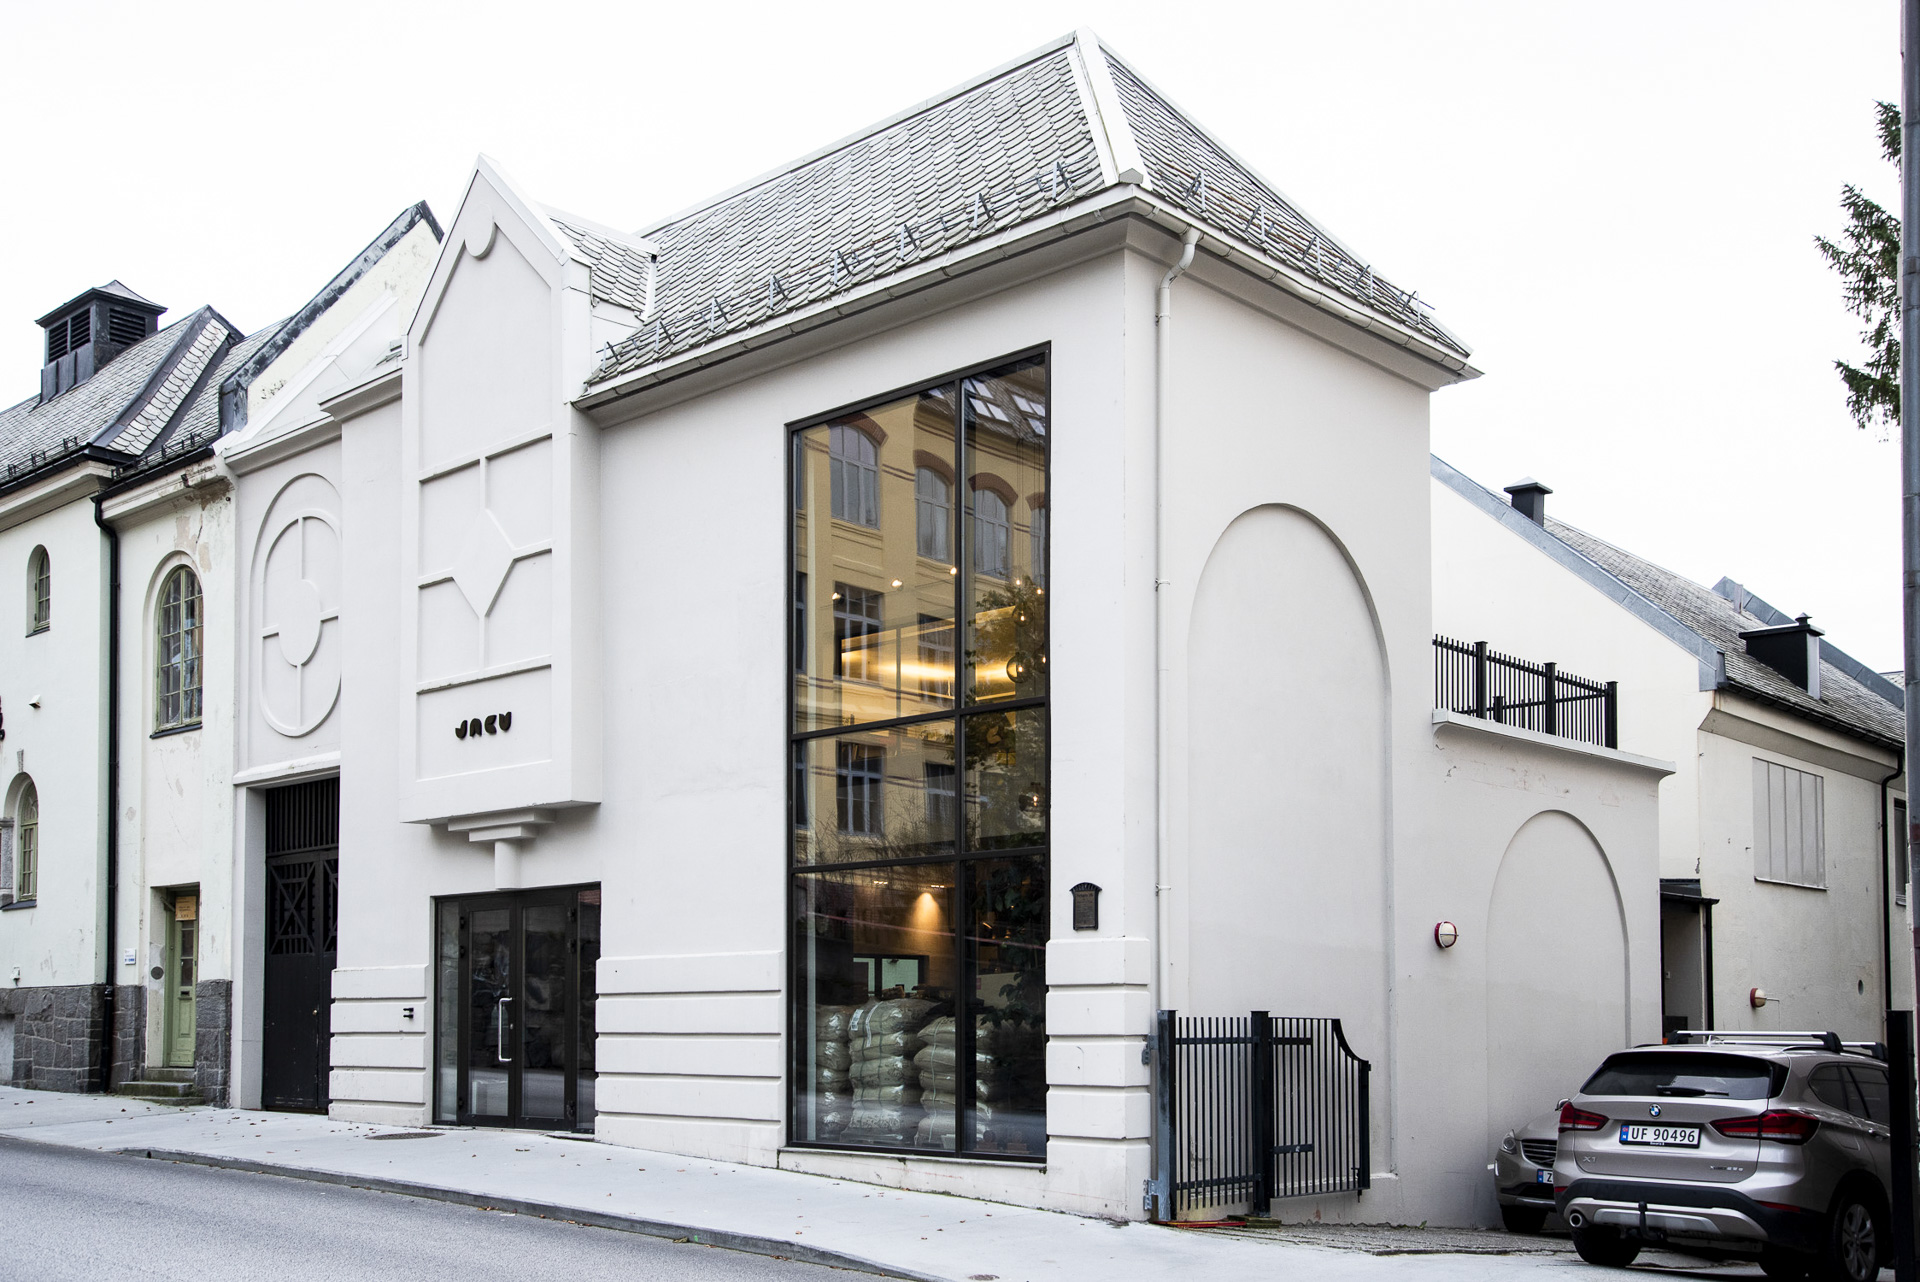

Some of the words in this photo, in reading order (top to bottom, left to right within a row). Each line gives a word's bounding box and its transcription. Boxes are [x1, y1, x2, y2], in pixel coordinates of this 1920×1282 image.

[455, 711, 512, 740] JACU
[1631, 1127, 1648, 1140] UF
[1653, 1128, 1694, 1142] 90496
[1546, 1172, 1553, 1182] Z
